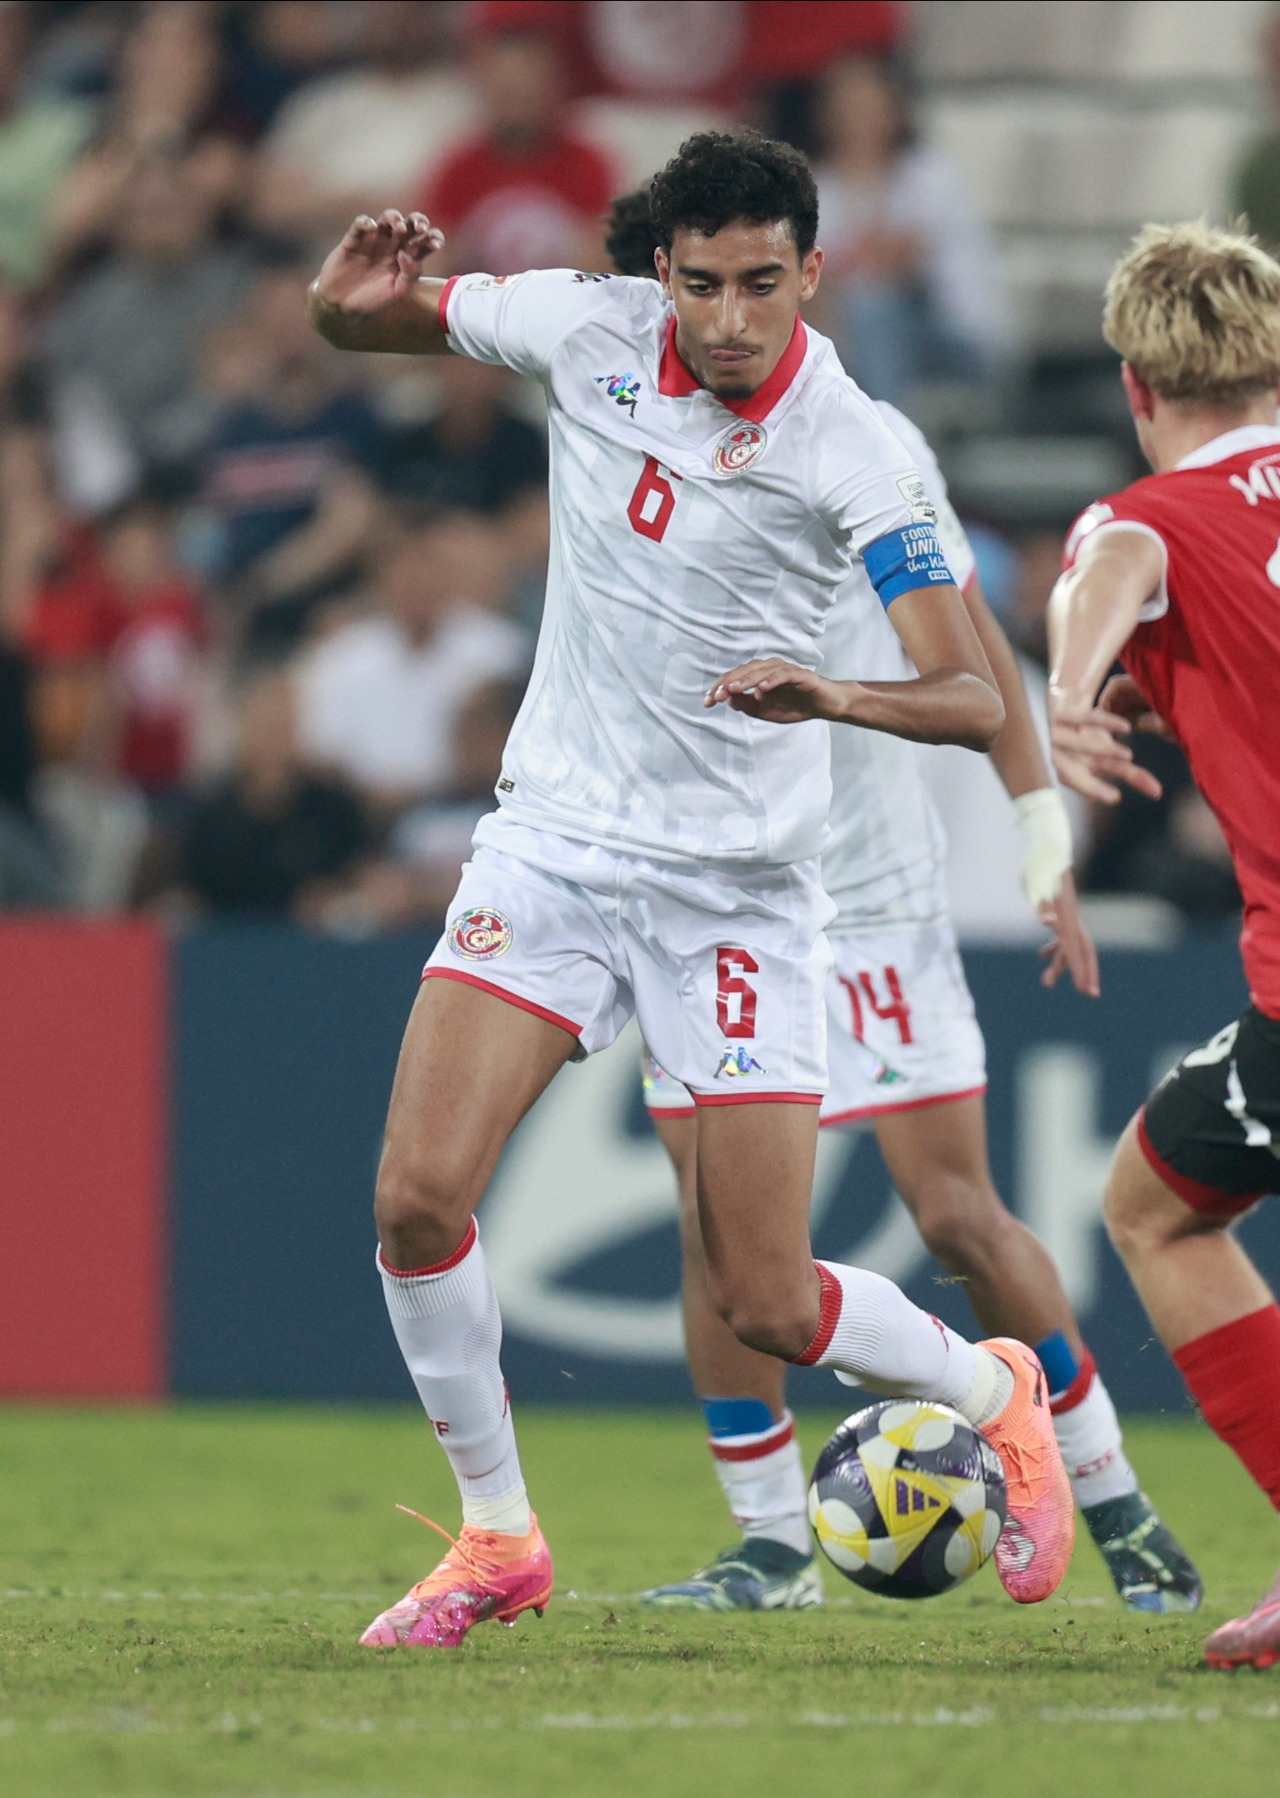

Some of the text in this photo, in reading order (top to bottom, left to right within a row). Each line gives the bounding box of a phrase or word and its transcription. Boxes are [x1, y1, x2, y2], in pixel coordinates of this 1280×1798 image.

[626, 450, 683, 544] 6
[716, 948, 759, 1039] 6
[838, 966, 914, 1045] 14
